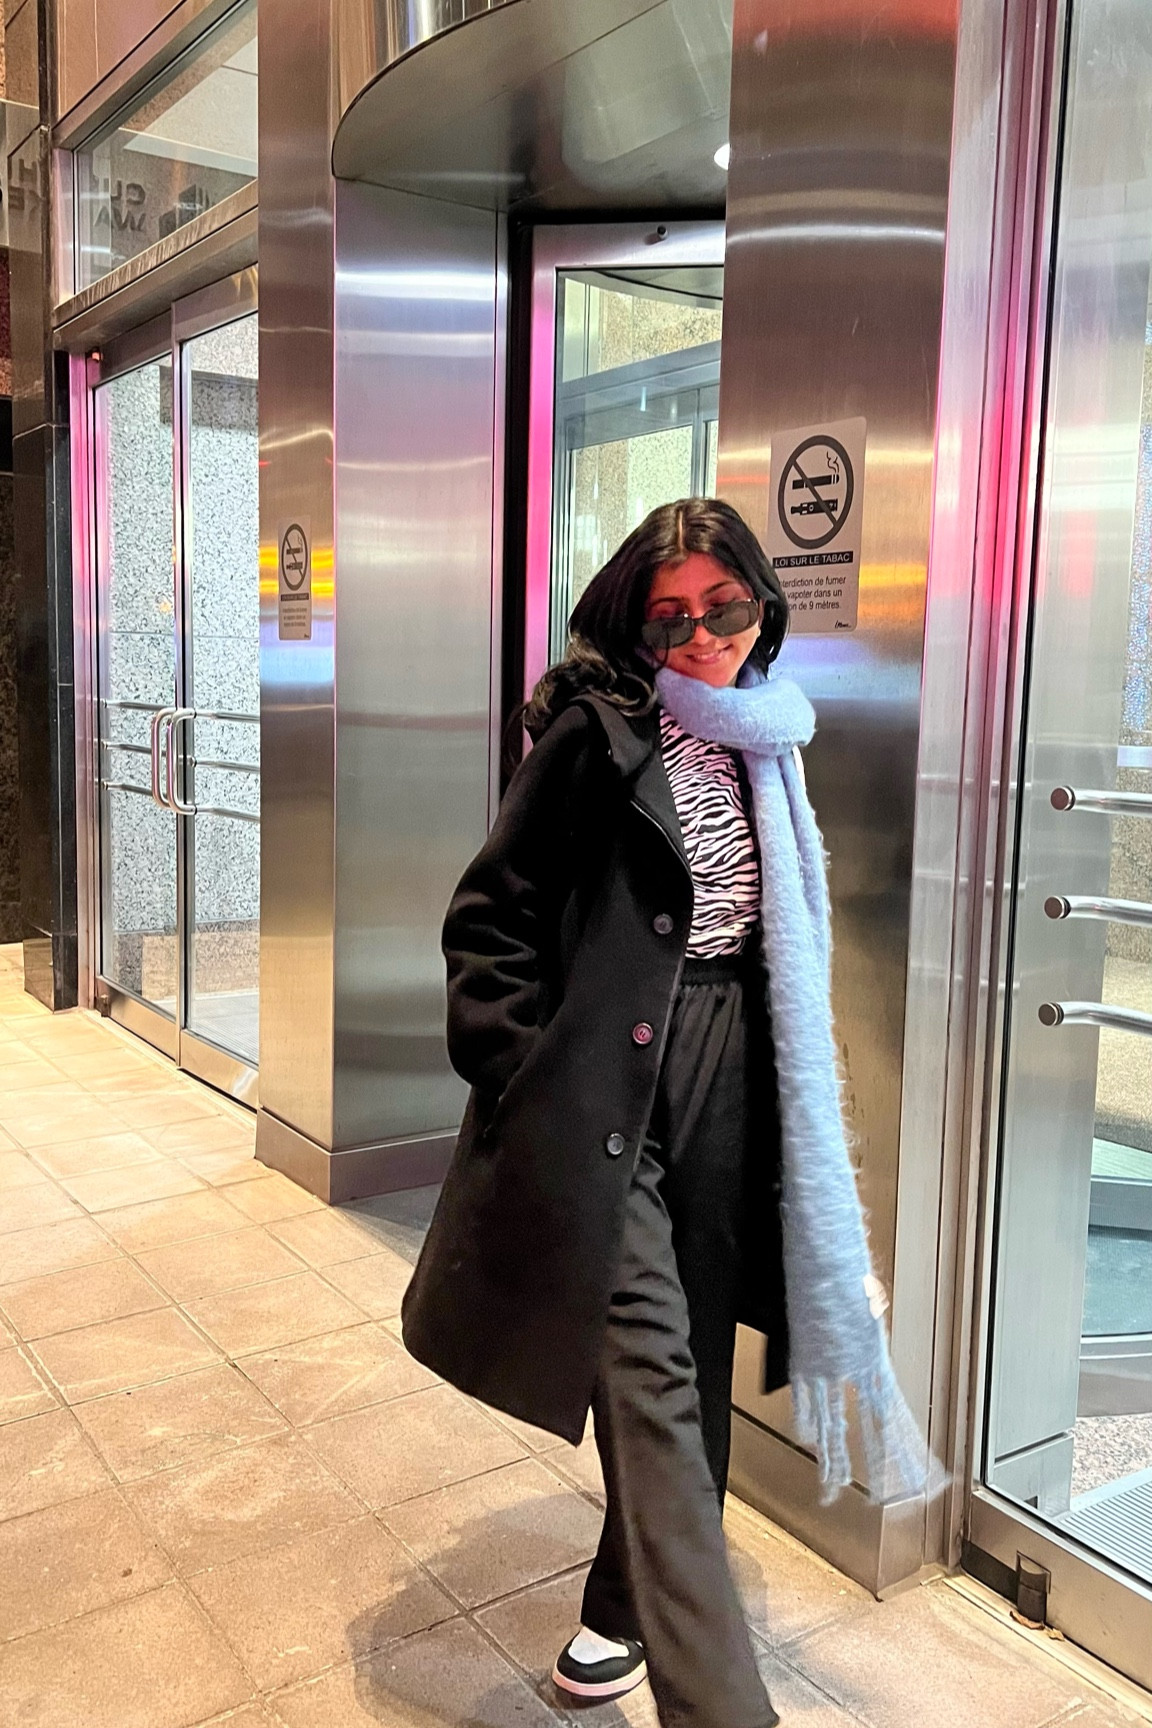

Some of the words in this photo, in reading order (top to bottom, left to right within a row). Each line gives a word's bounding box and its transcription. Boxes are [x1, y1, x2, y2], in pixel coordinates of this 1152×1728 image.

[775, 559, 788, 567] LOI
[790, 557, 807, 566] SUR
[809, 555, 819, 565] LE
[822, 553, 850, 563] TABAC
[782, 578, 813, 588] terdiction
[815, 577, 824, 586] de
[826, 576, 846, 585] fumer
[787, 590, 812, 600] vapoter
[814, 589, 831, 598] dans
[833, 589, 842, 597] un
[799, 602, 807, 610] de
[809, 601, 814, 609] 9
